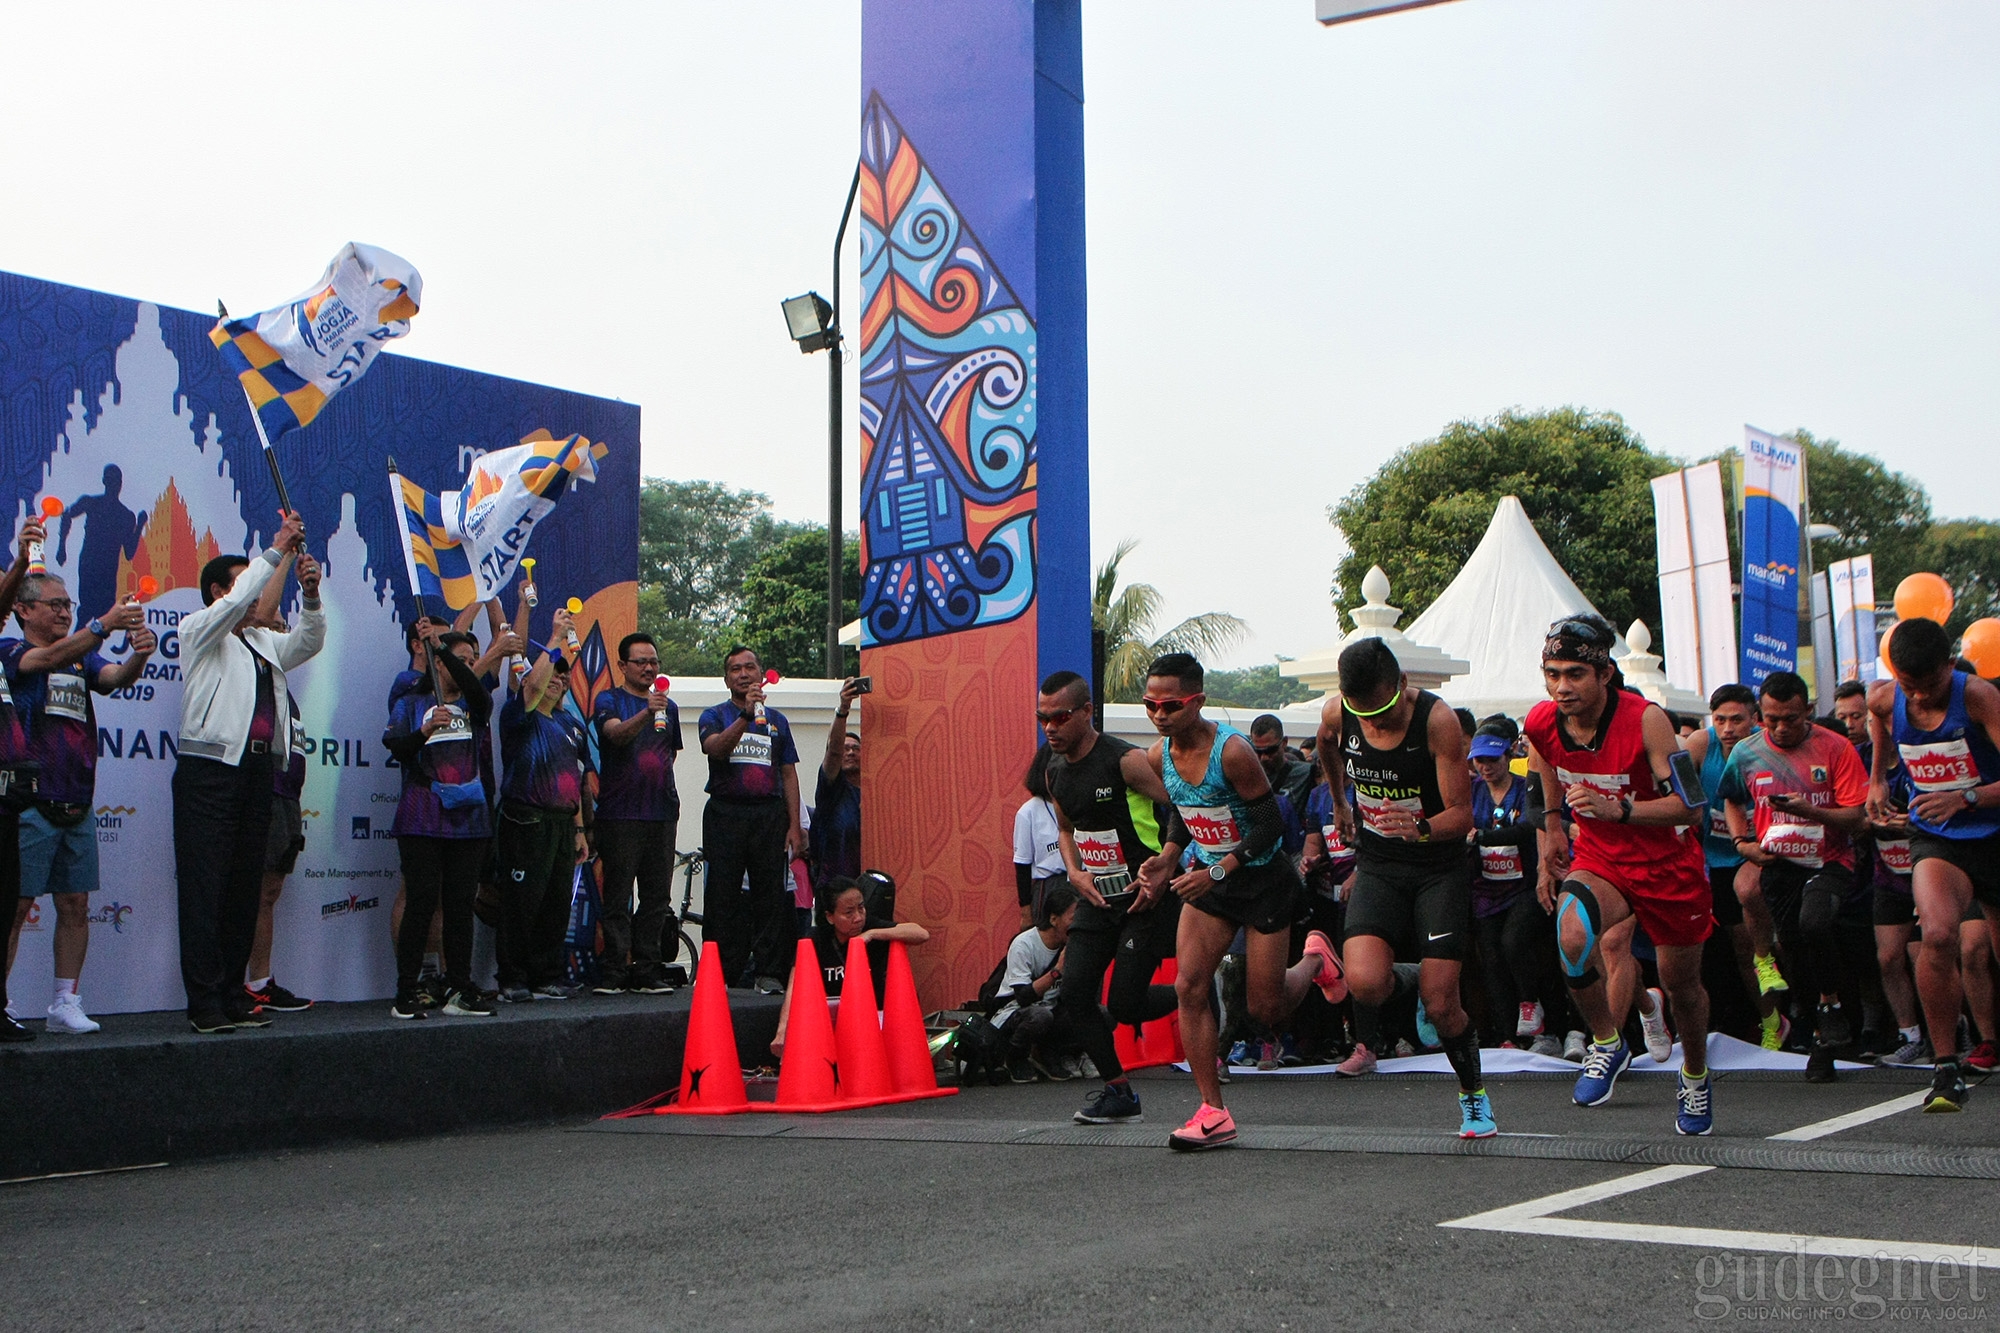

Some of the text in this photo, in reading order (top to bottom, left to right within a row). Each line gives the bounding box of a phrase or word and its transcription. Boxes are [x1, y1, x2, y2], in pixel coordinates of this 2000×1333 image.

[316, 306, 353, 339] JOGJA
[324, 314, 359, 345] MARATHON
[330, 337, 345, 351] 2019
[1751, 440, 1796, 465] BUMN
[480, 508, 535, 591] START
[1748, 563, 1786, 585] mandiri
[1753, 633, 1787, 653] saatnya
[1746, 648, 1793, 673] menabung
[110, 684, 155, 701] 2019
[733, 744, 768, 756] M1999
[1355, 767, 1380, 778] astra
[1382, 769, 1398, 786] life
[1909, 761, 1969, 779] M3913
[1811, 790, 1830, 806] DKI
[1185, 823, 1232, 840] M3113
[1079, 848, 1118, 861] M4003
[1768, 841, 1818, 854] M3805
[305, 868, 326, 879] Race
[327, 867, 382, 880] Management
[1483, 860, 1514, 870] F3080
[322, 896, 379, 915] MESA RACE
